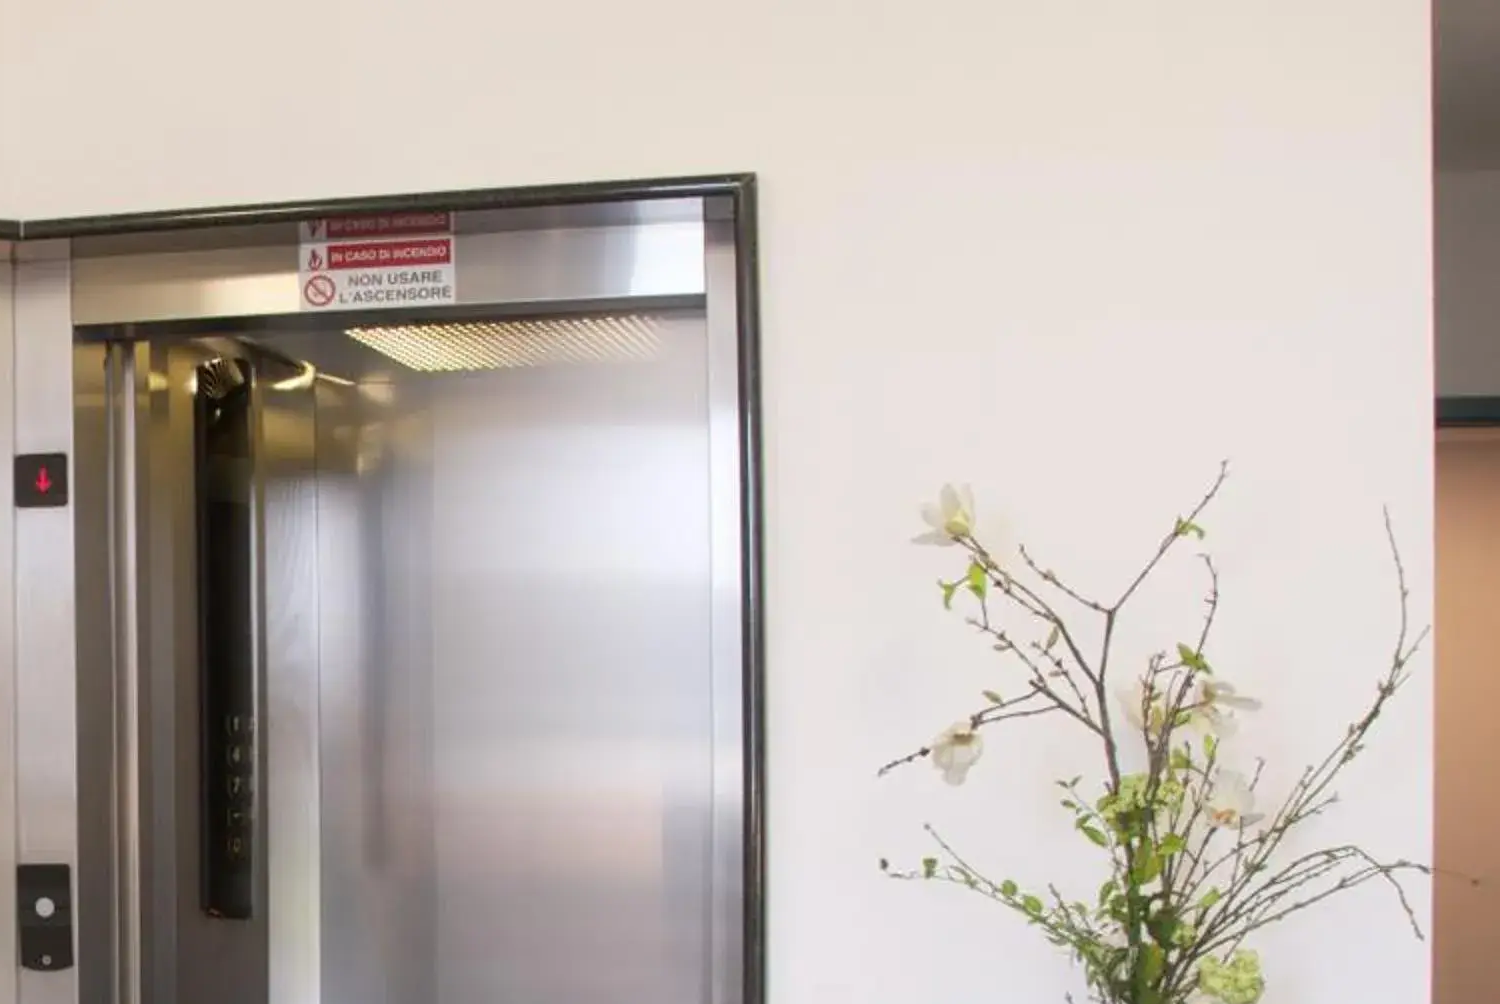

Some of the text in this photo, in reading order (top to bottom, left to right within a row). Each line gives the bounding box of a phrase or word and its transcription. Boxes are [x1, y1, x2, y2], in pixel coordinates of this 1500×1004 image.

[331, 246, 446, 263] IN CASO DI INCENDIO
[348, 270, 442, 286] NON USARE
[339, 286, 452, 304] L'ASCENSORE
